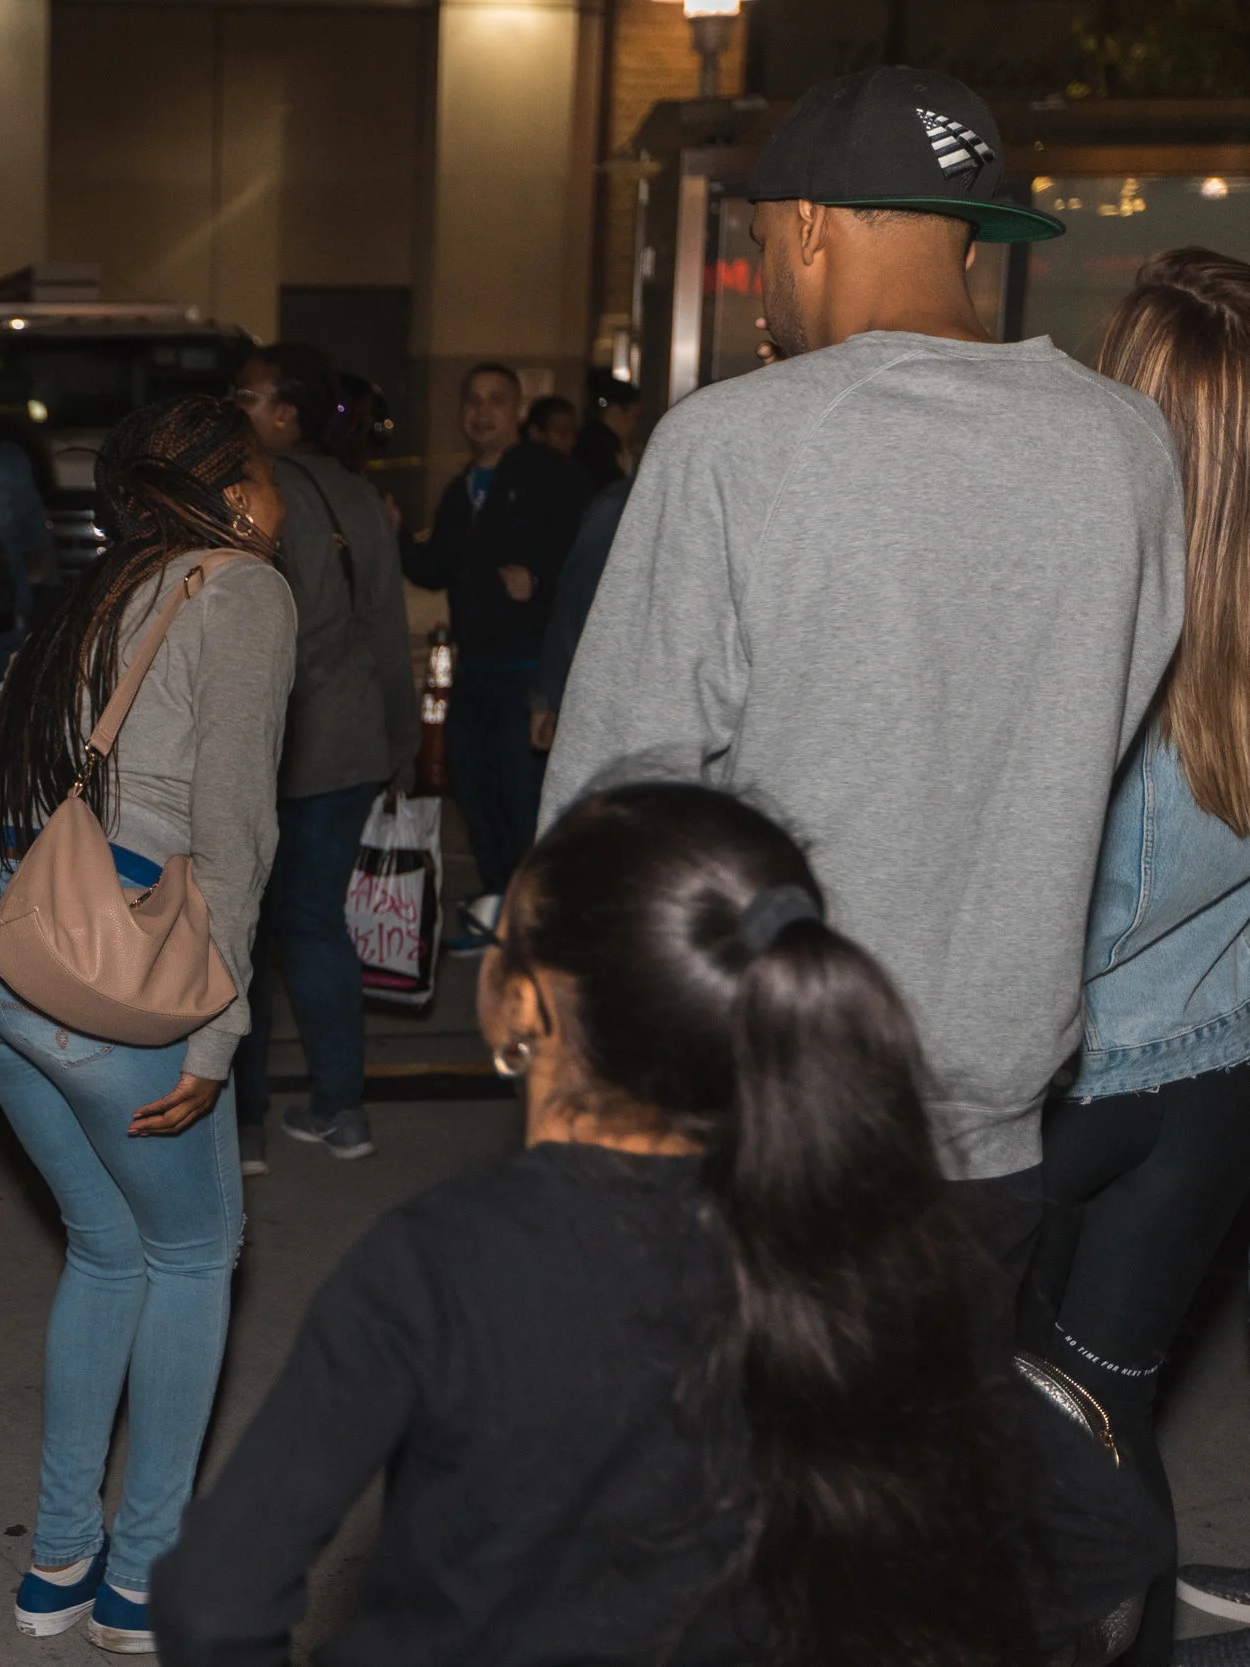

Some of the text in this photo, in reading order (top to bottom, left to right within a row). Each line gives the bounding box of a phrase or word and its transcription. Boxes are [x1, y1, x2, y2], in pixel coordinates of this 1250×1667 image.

[1065, 1335, 1076, 1346] NO
[1078, 1347, 1100, 1362] TIME
[1101, 1361, 1120, 1373] FOR
[1121, 1368, 1142, 1377] NEXT
